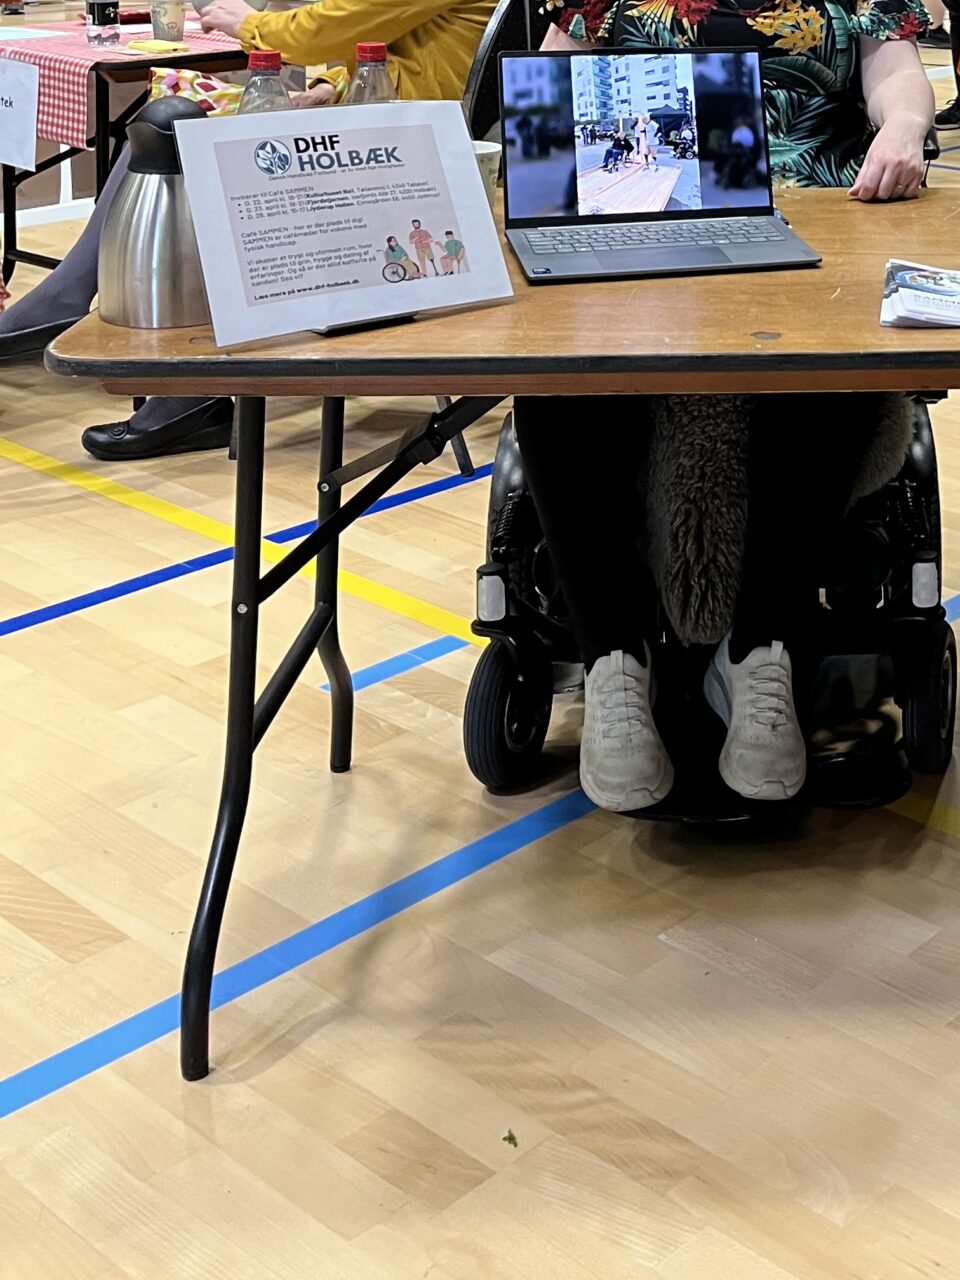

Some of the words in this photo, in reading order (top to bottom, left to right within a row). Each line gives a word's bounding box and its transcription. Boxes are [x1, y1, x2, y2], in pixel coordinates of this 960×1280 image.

[0, 96, 14, 109] tek
[293, 134, 341, 153] DHF
[297, 146, 405, 171] HOLBÆK
[284, 186, 314, 195] SAMMEN
